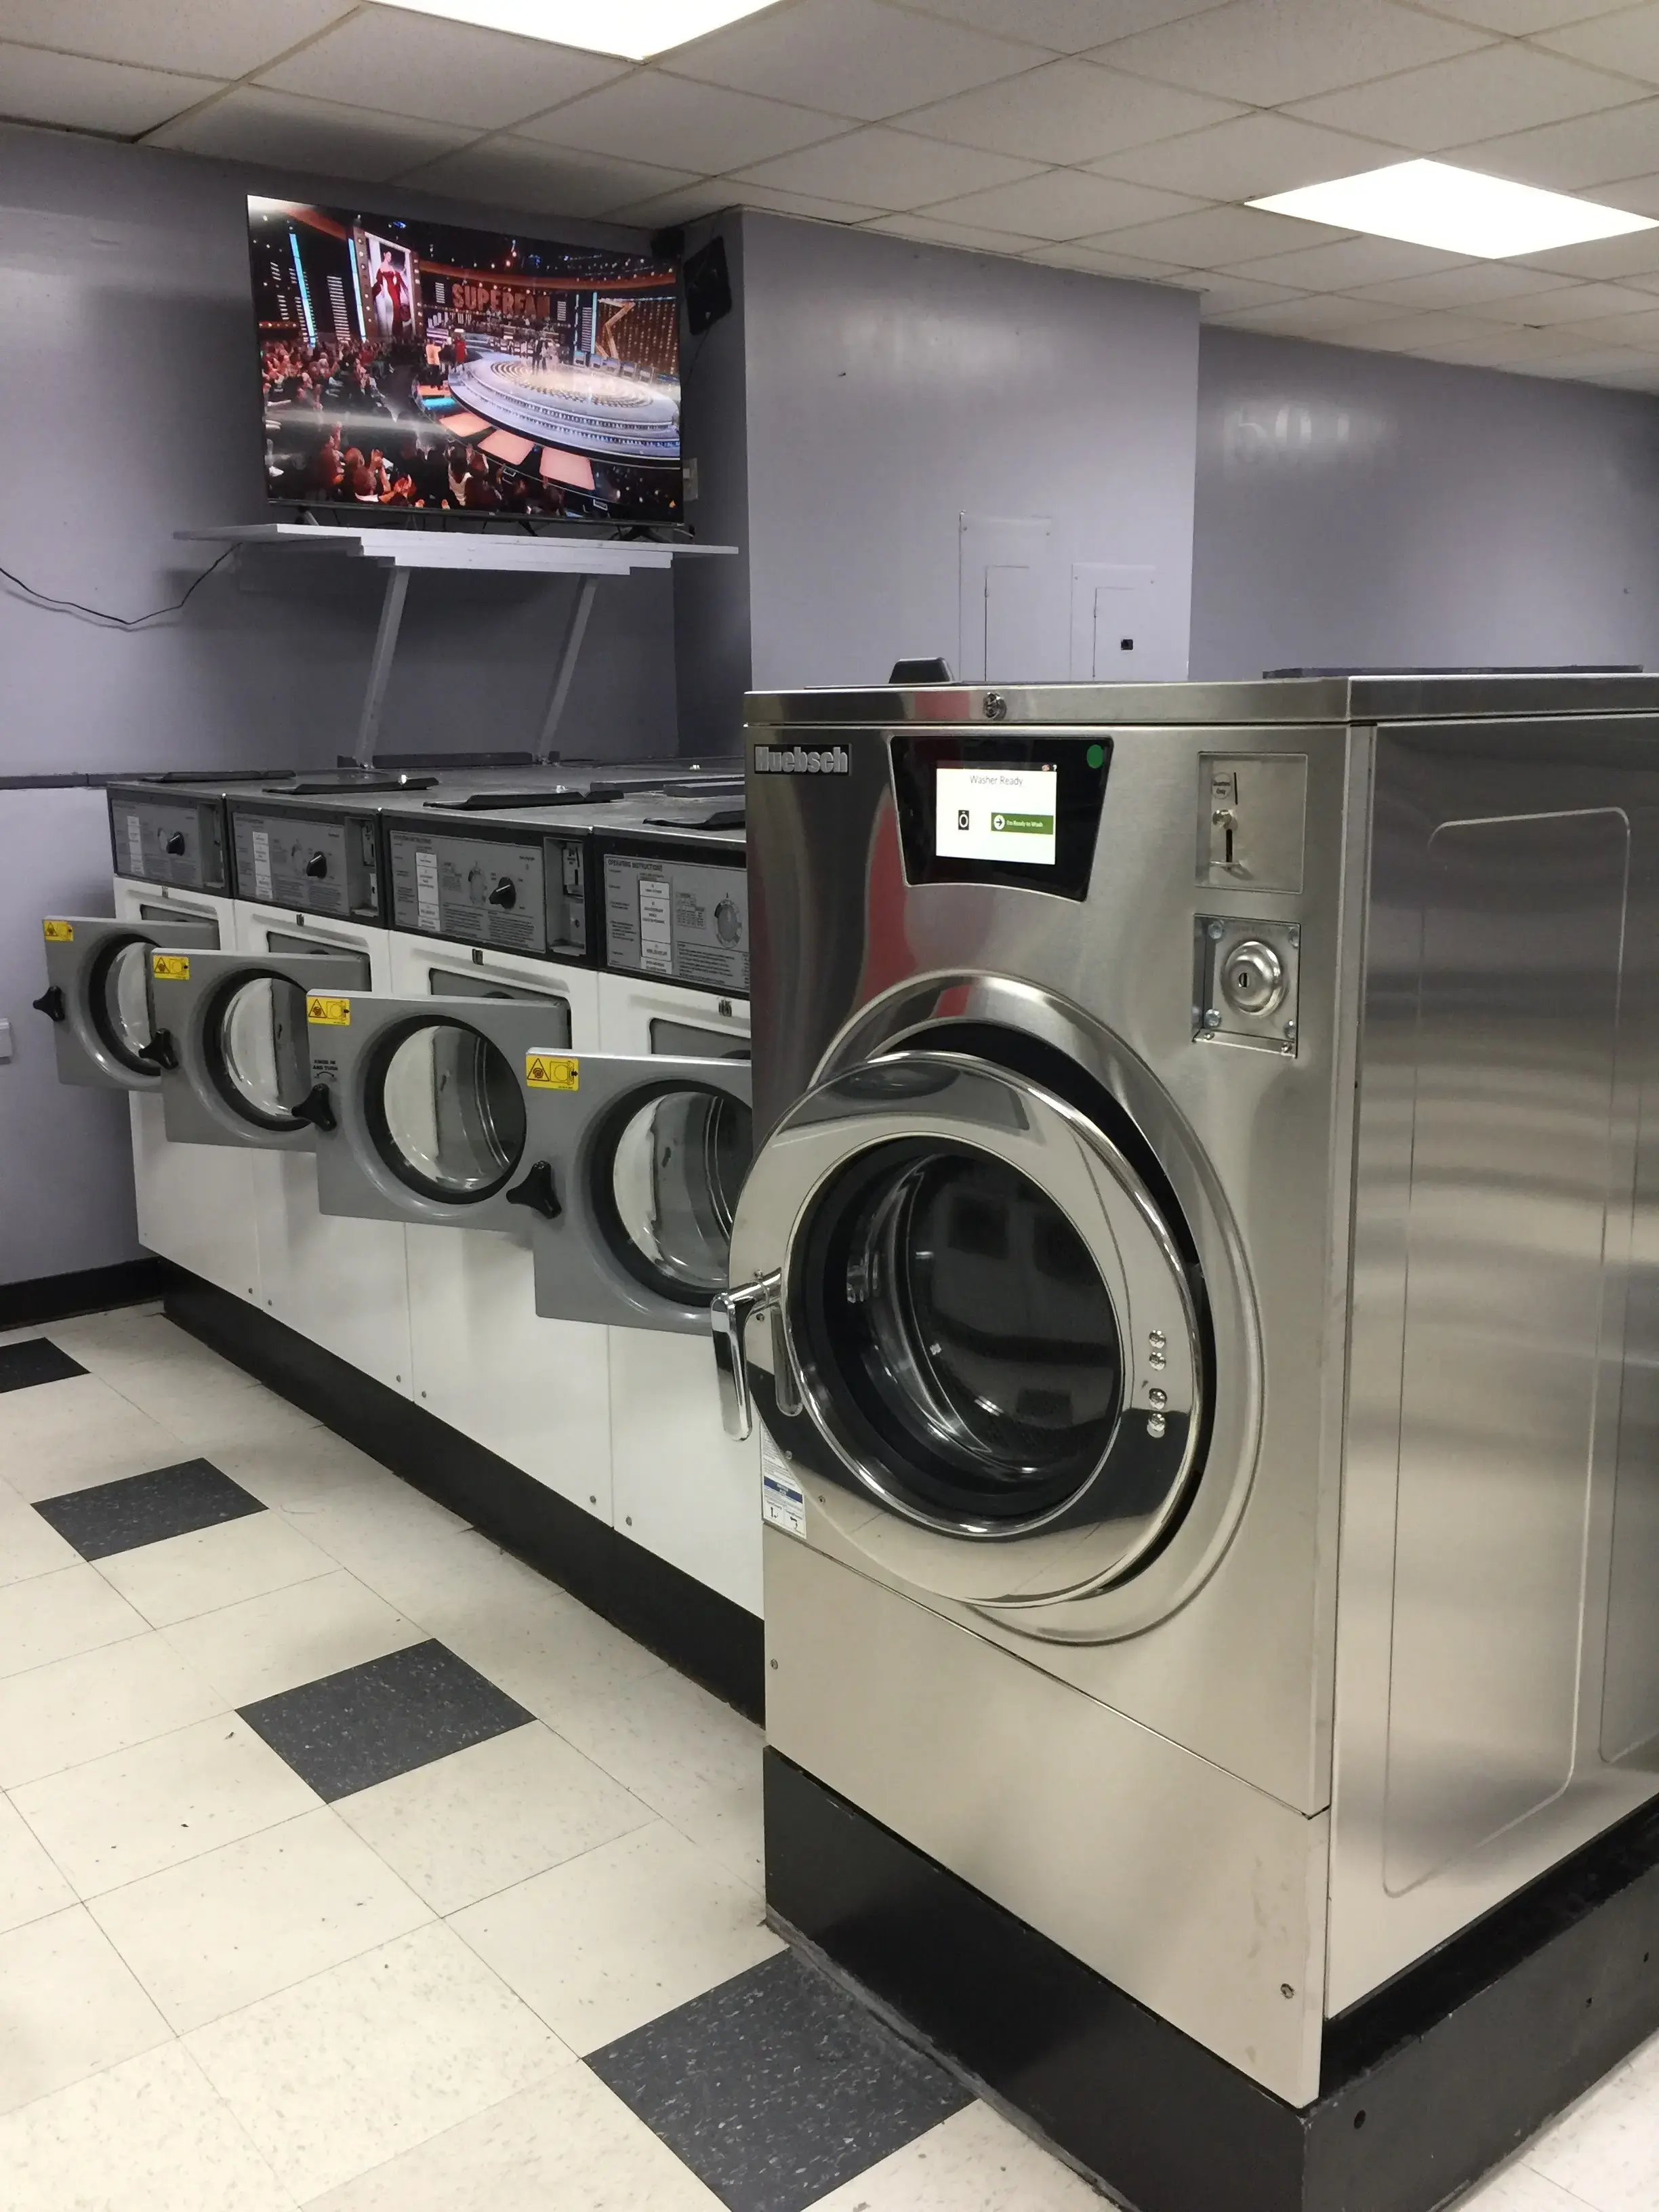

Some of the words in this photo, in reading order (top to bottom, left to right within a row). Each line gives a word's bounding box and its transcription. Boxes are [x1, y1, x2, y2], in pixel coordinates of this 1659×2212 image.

[755, 746, 848, 773] Huebsch
[970, 775, 998, 785] Washer
[1000, 775, 1023, 786] Ready
